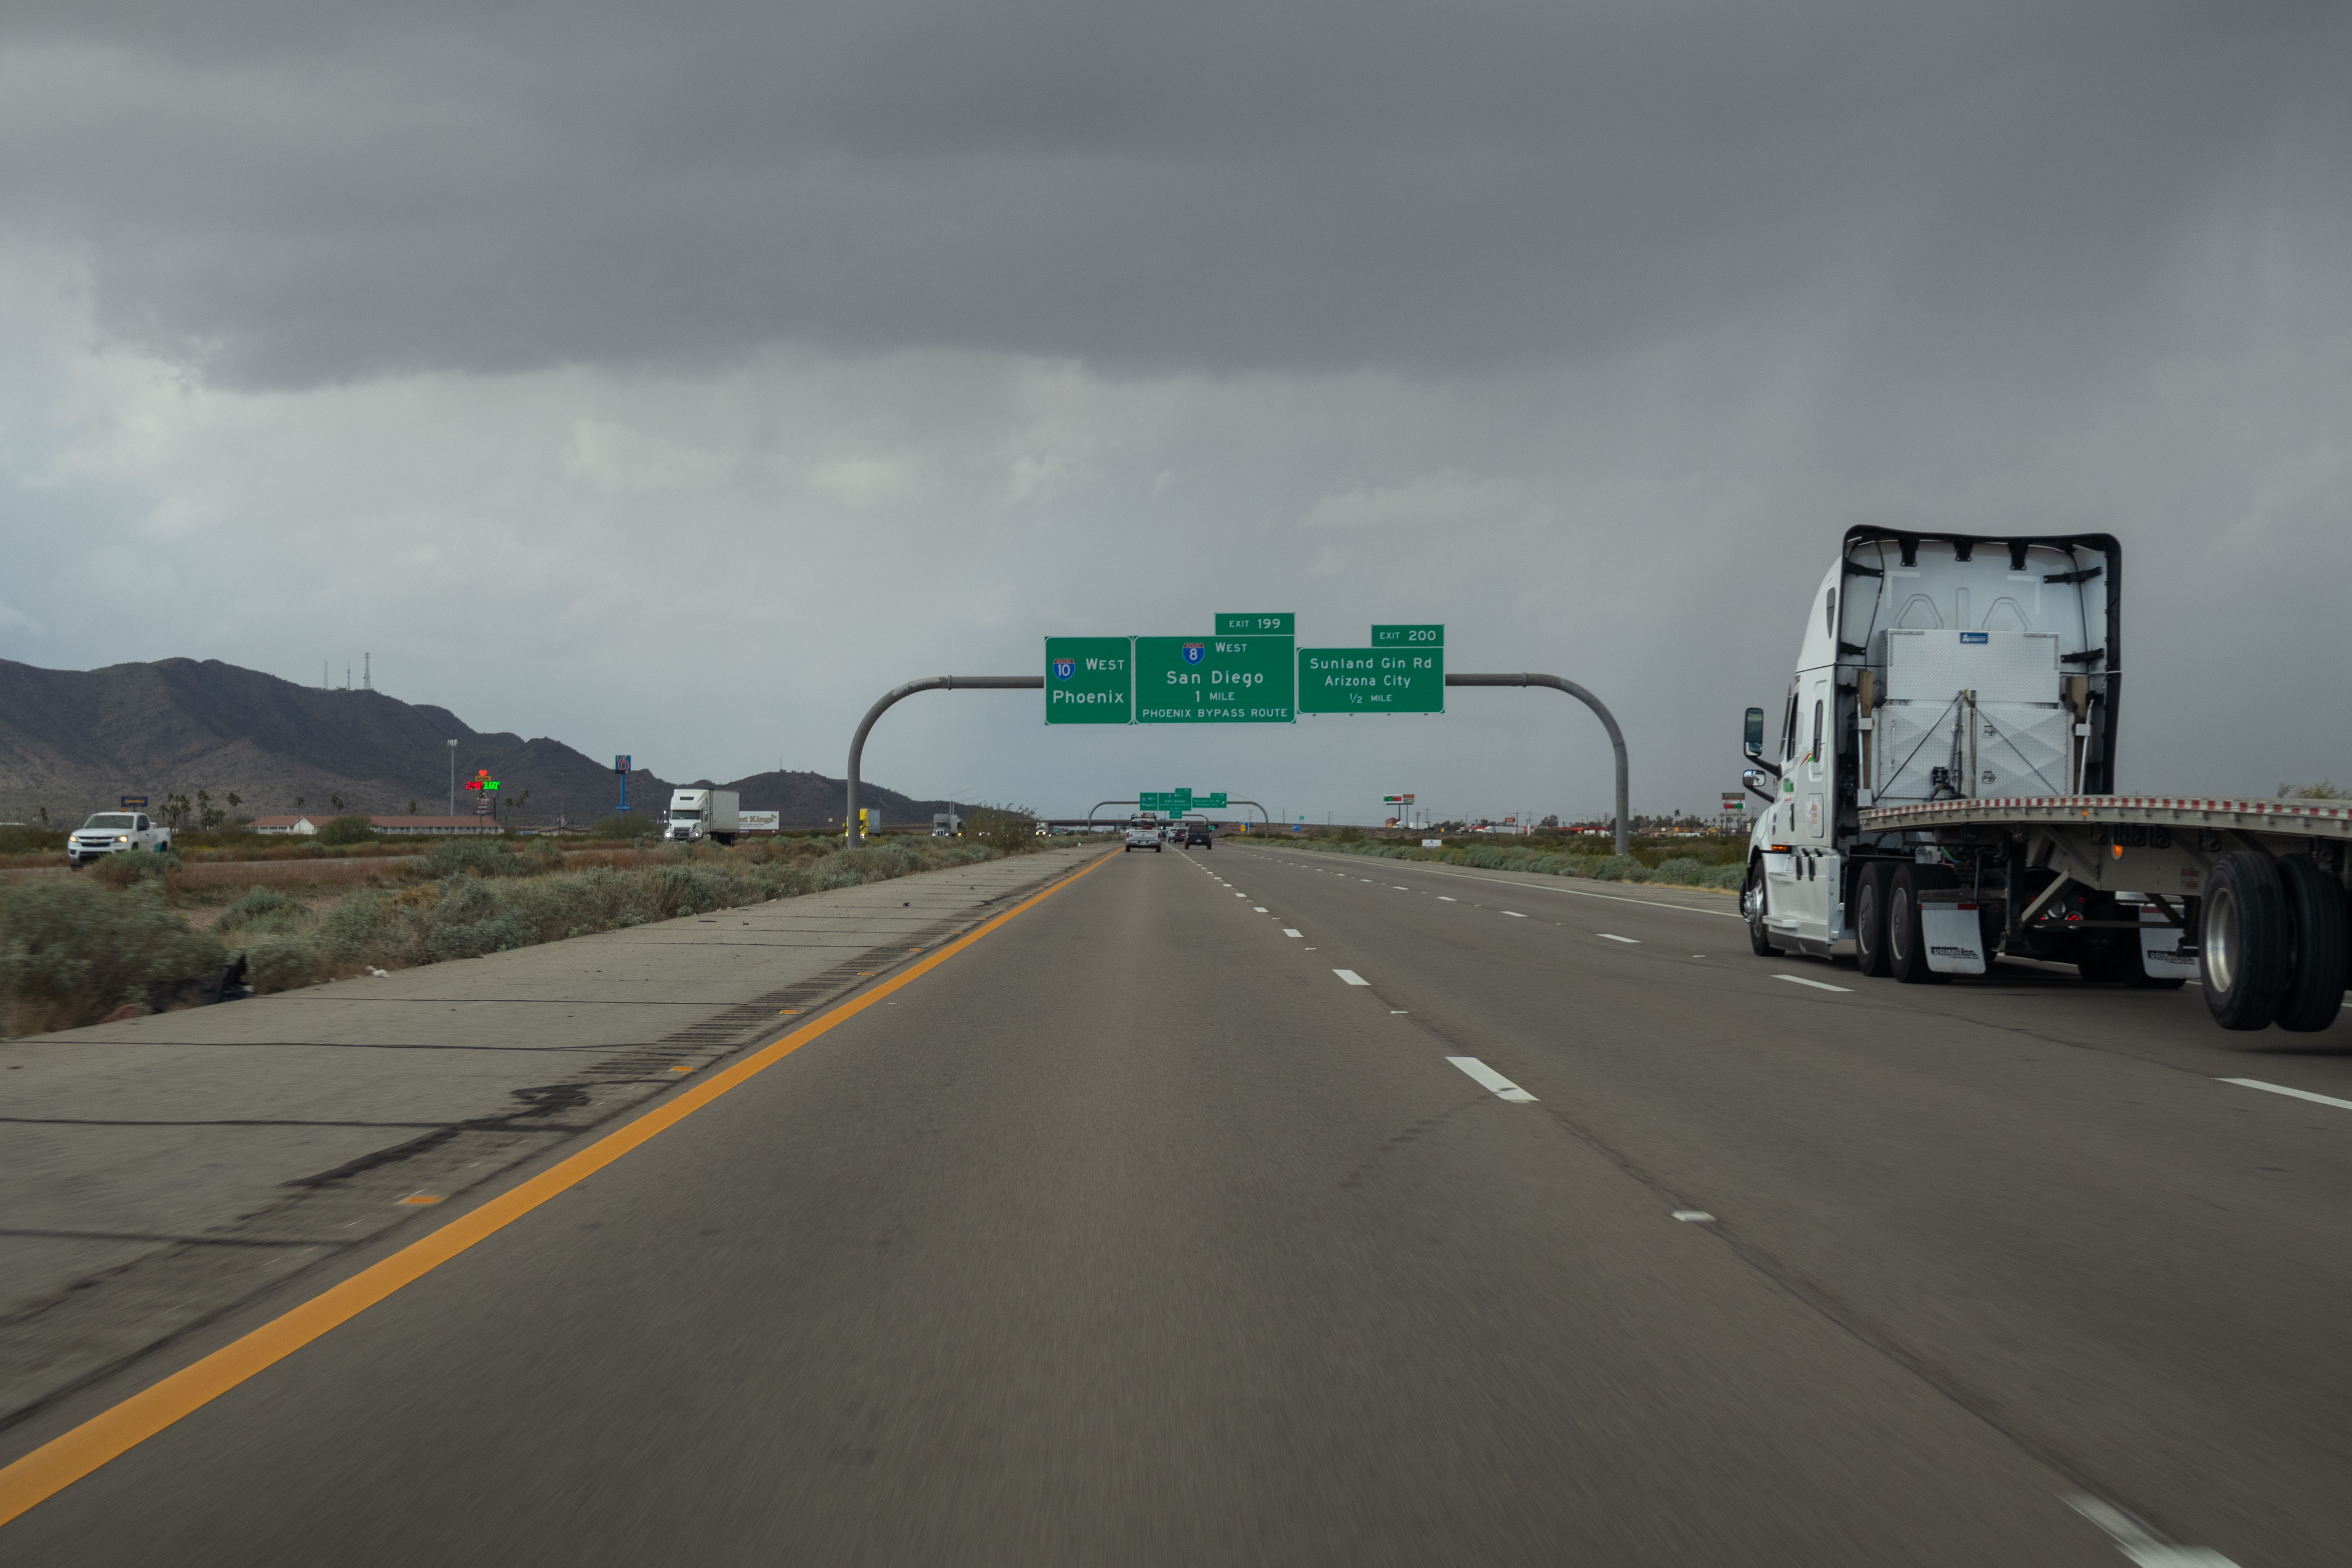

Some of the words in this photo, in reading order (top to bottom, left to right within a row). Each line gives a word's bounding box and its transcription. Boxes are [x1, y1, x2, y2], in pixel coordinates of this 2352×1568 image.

[1258, 618, 1281, 629] 199
[1408, 630, 1436, 641] 200
[1215, 642, 1247, 652] WEST
[1190, 648, 1198, 660] 8
[1086, 658, 1125, 670] WEST
[1310, 658, 1373, 669] Sunland
[1381, 658, 1406, 669] Gin
[1413, 658, 1432, 668] Rd
[1058, 664, 1070, 676] 10
[1166, 671, 1201, 684] San
[1211, 670, 1263, 687] Diego
[1325, 676, 1376, 686] Arizona
[1384, 675, 1411, 688] City
[1053, 690, 1124, 703] Phoenix
[1195, 690, 1200, 702] 1
[1209, 692, 1234, 700] MILE
[1142, 709, 1191, 718] PHOENIX
[1197, 709, 1245, 717] BYPASS
[1251, 708, 1287, 717] ROUTE
[618, 755, 629, 771] 6
[749, 816, 774, 824] Kings
